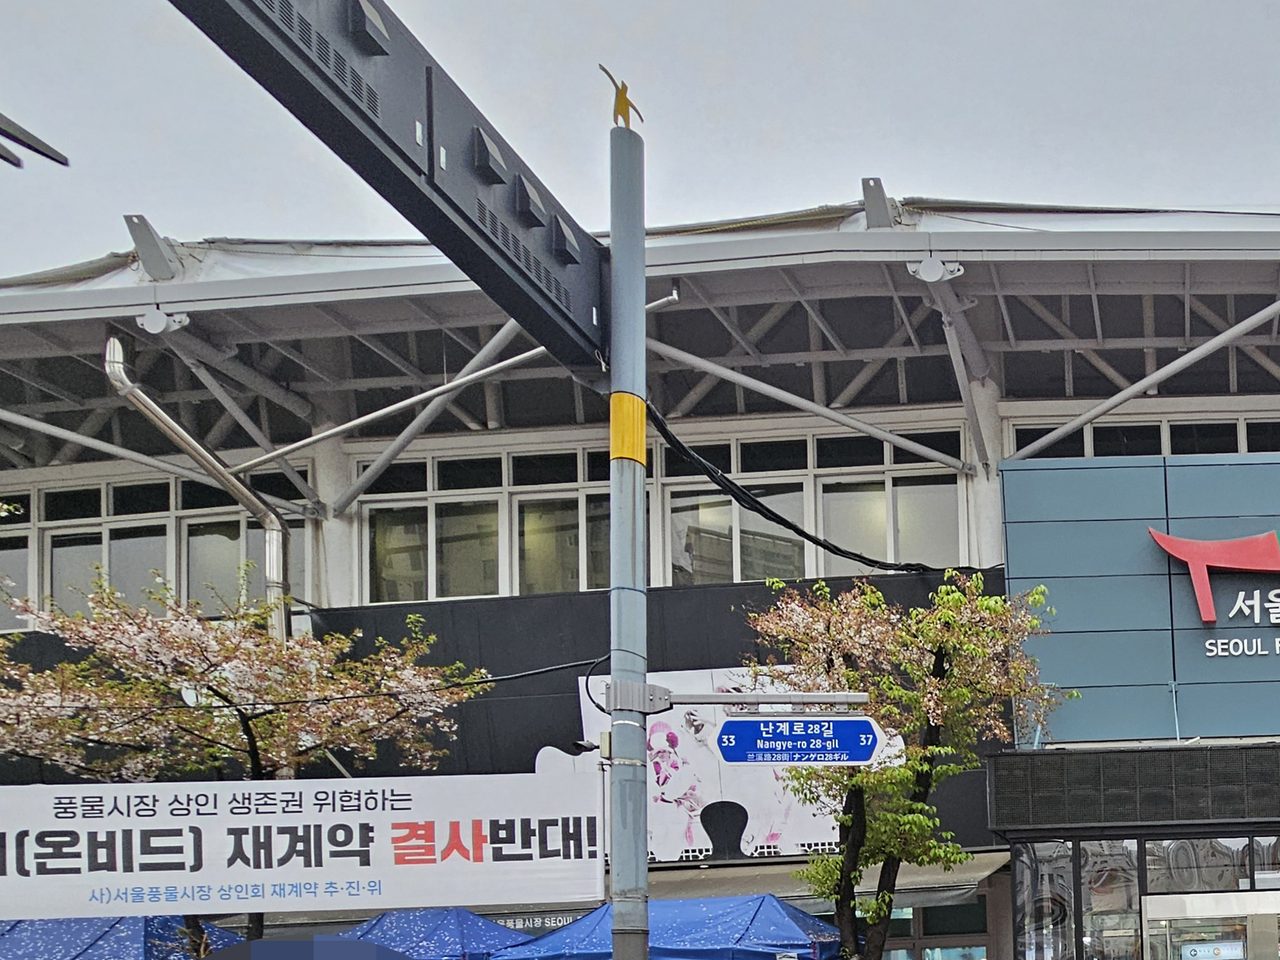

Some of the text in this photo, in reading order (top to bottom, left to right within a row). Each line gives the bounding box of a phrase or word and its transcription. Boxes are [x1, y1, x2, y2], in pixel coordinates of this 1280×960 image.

[1205, 637, 1269, 657] SEOUL
[721, 734, 736, 747] 33
[756, 738, 839, 750] Nangye-ro 28-gil
[859, 734, 873, 746] 37
[52, 788, 413, 820] 풍물시장 상인 생존권 위협하는
[0, 816, 598, 877] (온비드) 재계약 결사반대!
[89, 884, 213, 904] 사)서울풍물시장
[217, 883, 266, 900] 상인회
[271, 882, 318, 898] 재계약
